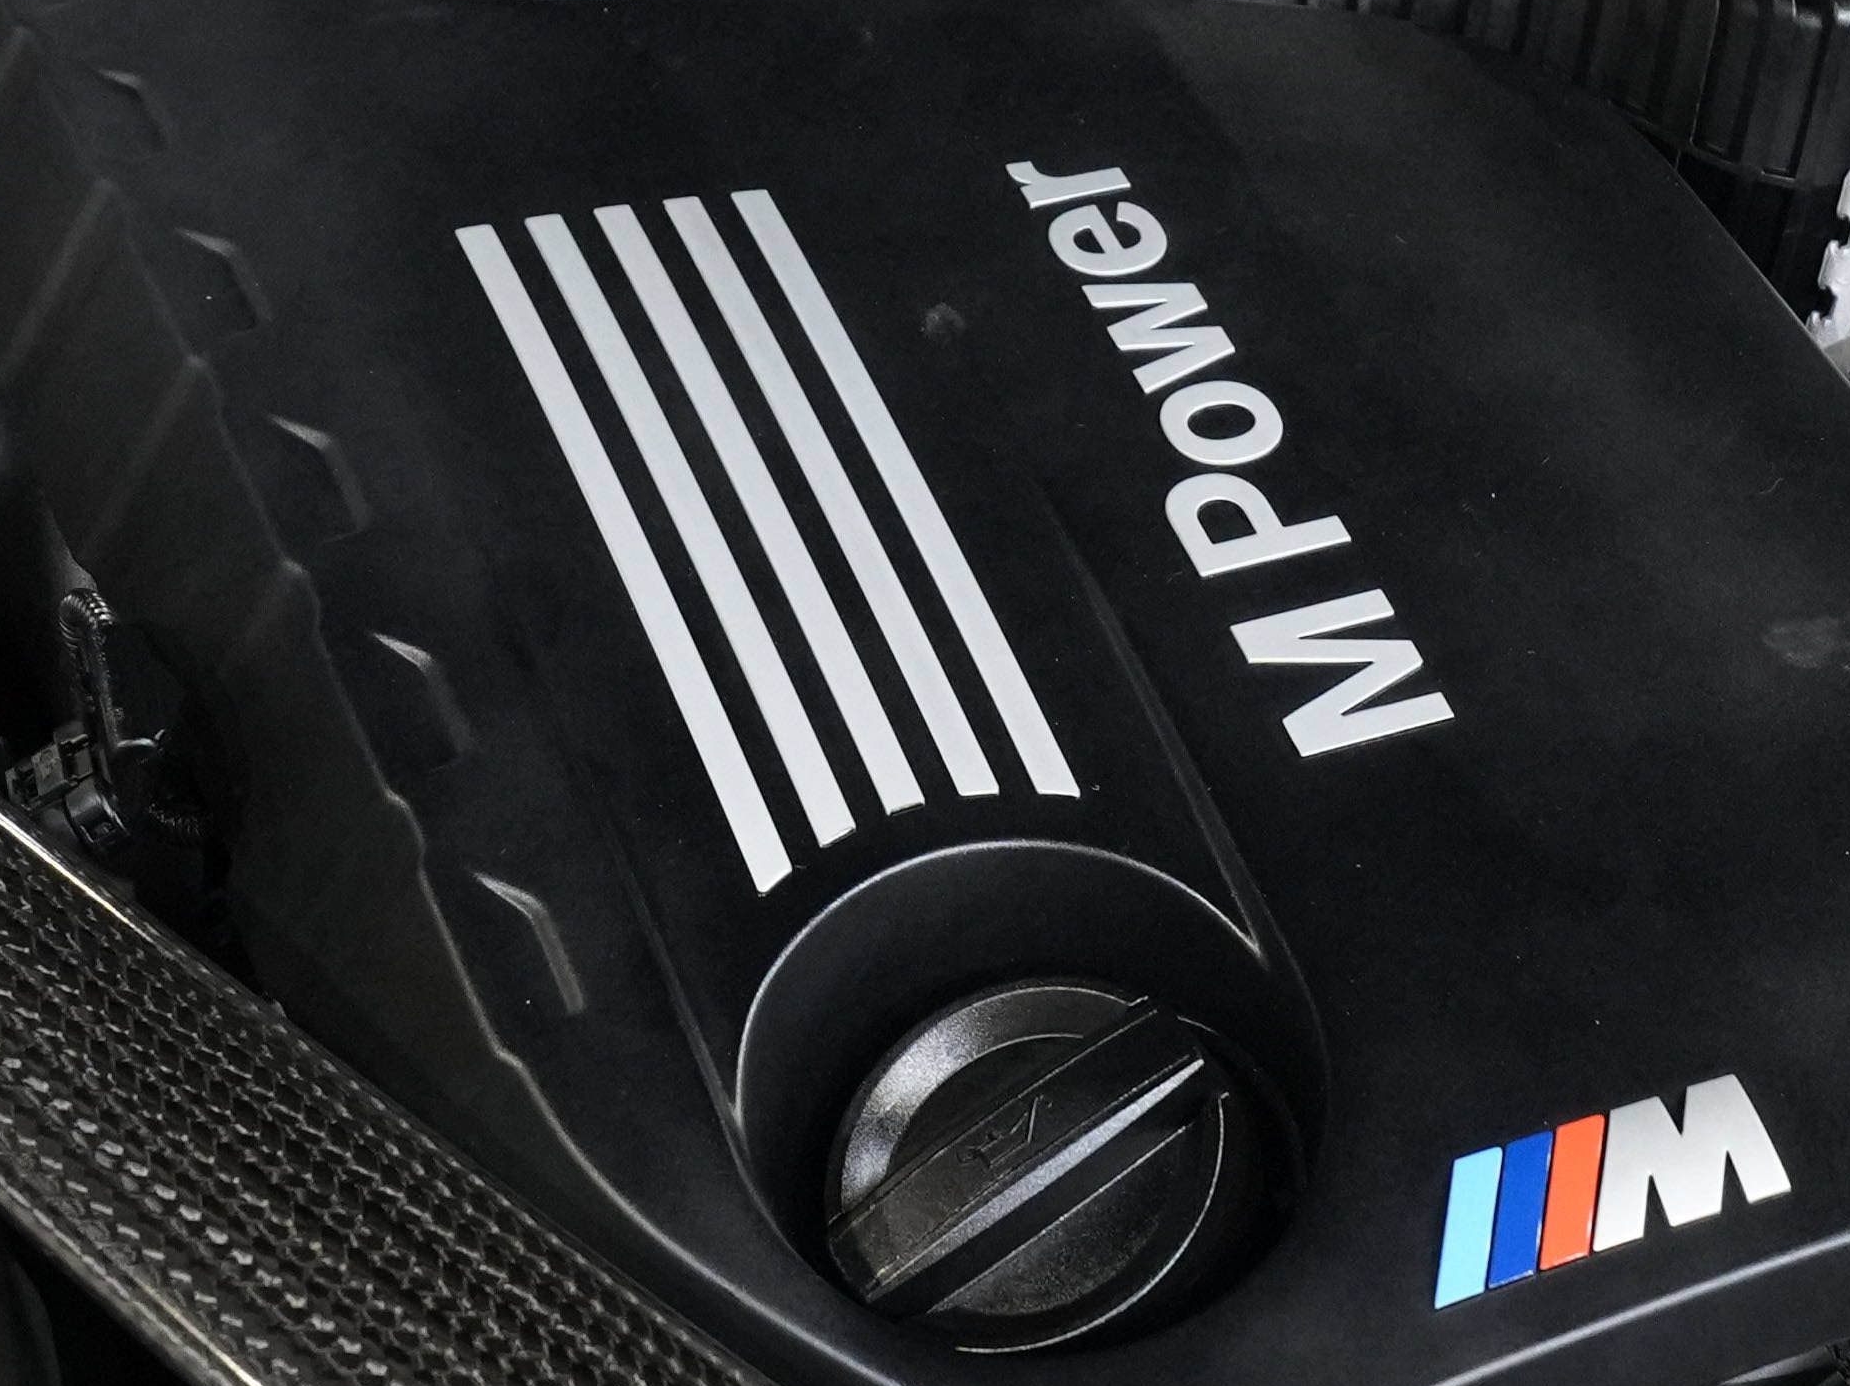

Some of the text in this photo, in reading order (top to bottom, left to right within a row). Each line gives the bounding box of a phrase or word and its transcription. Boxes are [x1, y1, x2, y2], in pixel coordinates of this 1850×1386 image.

[1004, 159, 1455, 758] M Power
[1590, 1073, 1793, 1254] M
